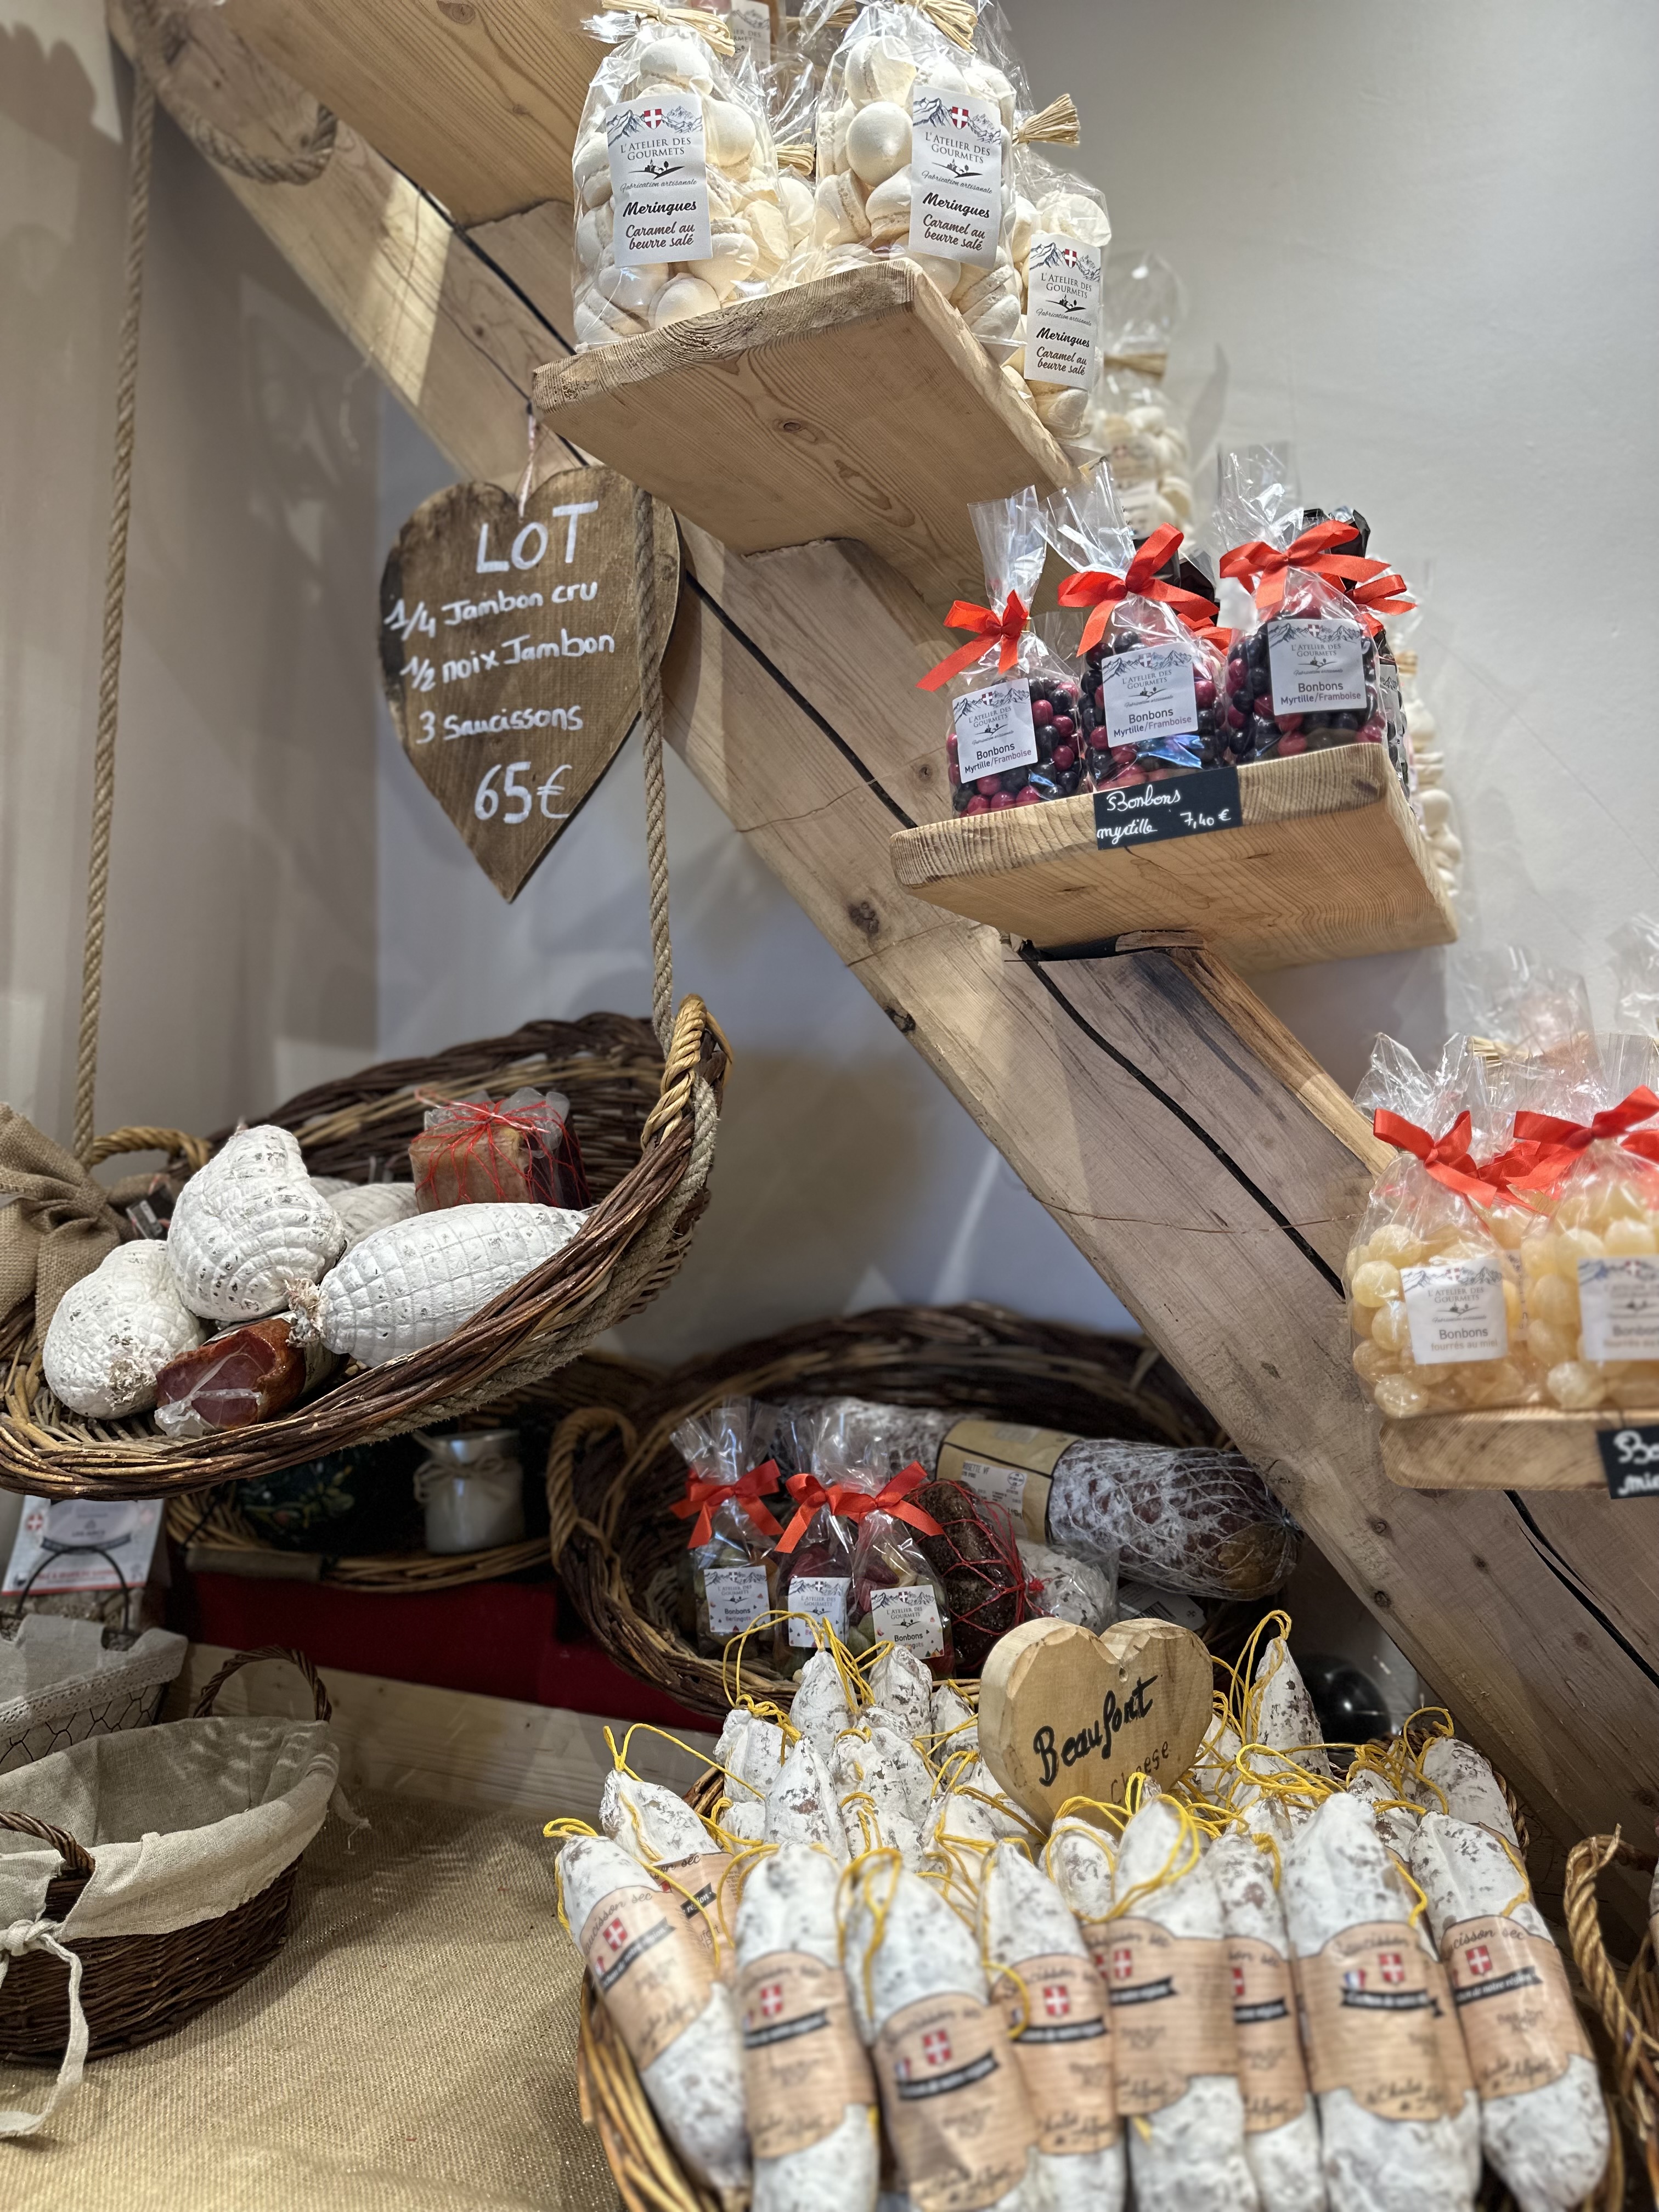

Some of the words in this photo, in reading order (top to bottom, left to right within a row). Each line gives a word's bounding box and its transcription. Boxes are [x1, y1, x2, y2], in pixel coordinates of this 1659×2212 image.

[620, 139, 669, 153] L'ATELIER
[673, 137, 691, 145] DES
[926, 132, 969, 151] L'ATELIER
[974, 142, 990, 156] DES
[628, 147, 685, 160] GOURMETS
[932, 144, 984, 163] GOURMETS
[620, 182, 659, 193] Fabrication
[661, 179, 697, 187] artisanale
[922, 171, 959, 186] Fabrication
[960, 182, 992, 194] artisanale
[623, 201, 697, 217] Meringues
[923, 192, 990, 218] Meringues
[626, 222, 675, 238] Caramel
[679, 223, 695, 233] au
[923, 214, 970, 235] Caramel
[971, 228, 985, 239] au
[629, 240, 667, 250] beurre
[670, 234, 693, 246] salé
[924, 229, 958, 245] beurre
[961, 238, 983, 251] salé
[1041, 273, 1078, 286] L'ATELIER
[1081, 281, 1092, 291] DES
[1046, 283, 1087, 298] GOURMETS
[1036, 309, 1068, 320] Fabrication
[1036, 328, 1090, 348] Meringues
[1036, 346, 1075, 362] Caramel
[1076, 357, 1087, 365] au
[1037, 358, 1066, 371] beurre
[1068, 365, 1086, 375] salé
[476, 500, 599, 575] LOT
[384, 599, 436, 641] 1/4
[443, 590, 543, 626] Jambon
[551, 582, 598, 603] cru
[400, 657, 436, 692] 1/2
[443, 651, 499, 684] noix
[501, 629, 615, 665] Jambon
[1122, 673, 1156, 684] L'ATELIER
[1127, 677, 1167, 690] GOURMETS
[1298, 681, 1344, 692] Bonbons
[1281, 692, 1361, 705] Myrtille/Framboise
[968, 710, 997, 723] L'ATELIER
[973, 714, 1008, 727] GOURMETS
[1129, 709, 1173, 724] Bonbons
[416, 710, 436, 745] 3
[443, 706, 583, 741] Saucissons
[1114, 716, 1192, 737] Myrtille/Framboise
[977, 743, 1015, 760] Bonbons
[965, 749, 1032, 774] Myrtille/Framboise
[475, 761, 573, 824] 65€
[1107, 784, 1181, 812] Bonbons
[1097, 819, 1158, 845] myrtille
[1435, 1295, 1479, 1304] GOURMETS
[1439, 1328, 1488, 1340] Bonbons
[1431, 1342, 1464, 1351] fourrés
[1480, 1339, 1498, 1347] miel
[894, 1633, 923, 1641] Bonbons
[1033, 1675, 1159, 1787] Beaufort
[681, 1855, 701, 1867] sec
[631, 1893, 653, 1903] sec
[1502, 1927, 1524, 1940] sec
